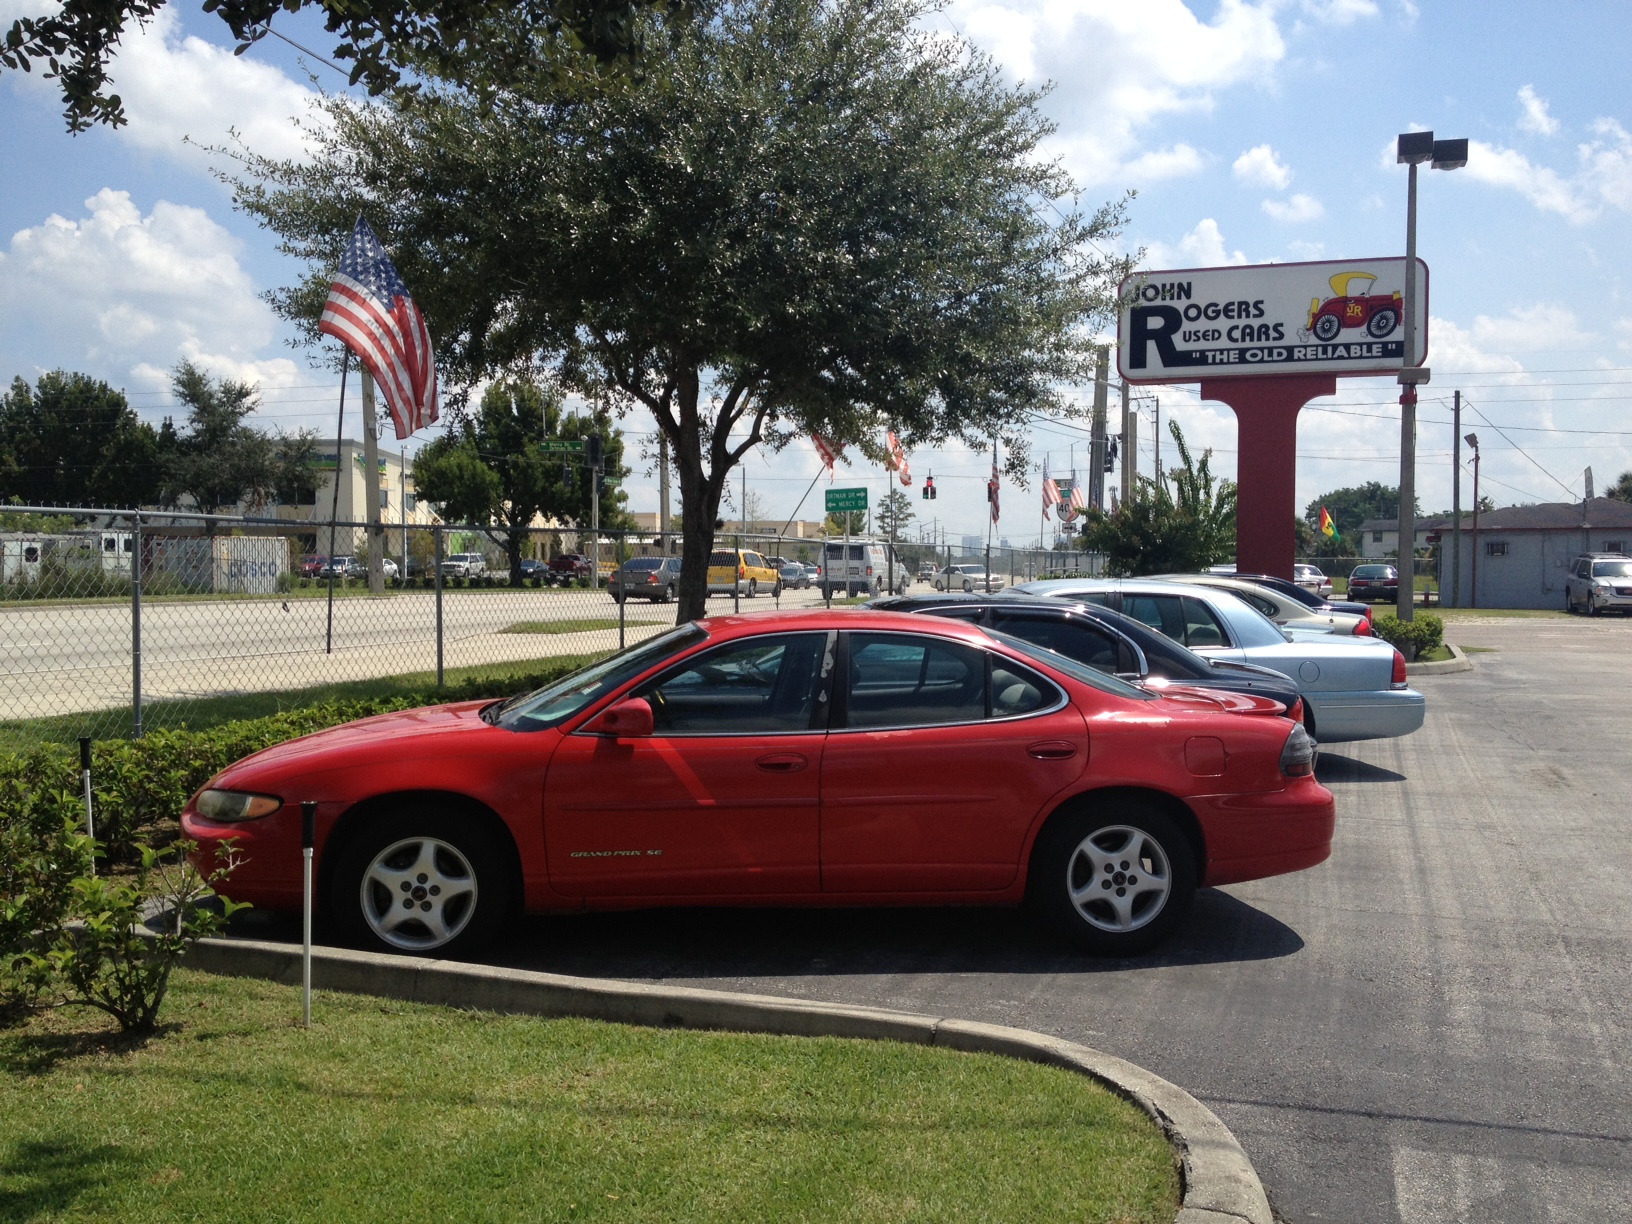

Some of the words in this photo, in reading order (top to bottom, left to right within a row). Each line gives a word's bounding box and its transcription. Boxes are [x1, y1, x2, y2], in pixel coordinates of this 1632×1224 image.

[1130, 281, 1192, 303] JOHN
[1182, 328, 1222, 343] USED
[1226, 322, 1285, 343] CARS
[1205, 350, 1240, 363] THE
[1245, 348, 1288, 362] OLD
[1293, 343, 1383, 360] RELIABLE
[570, 850, 613, 858] GRAND
[613, 849, 642, 857] PRIX
[646, 848, 663, 856] SE
